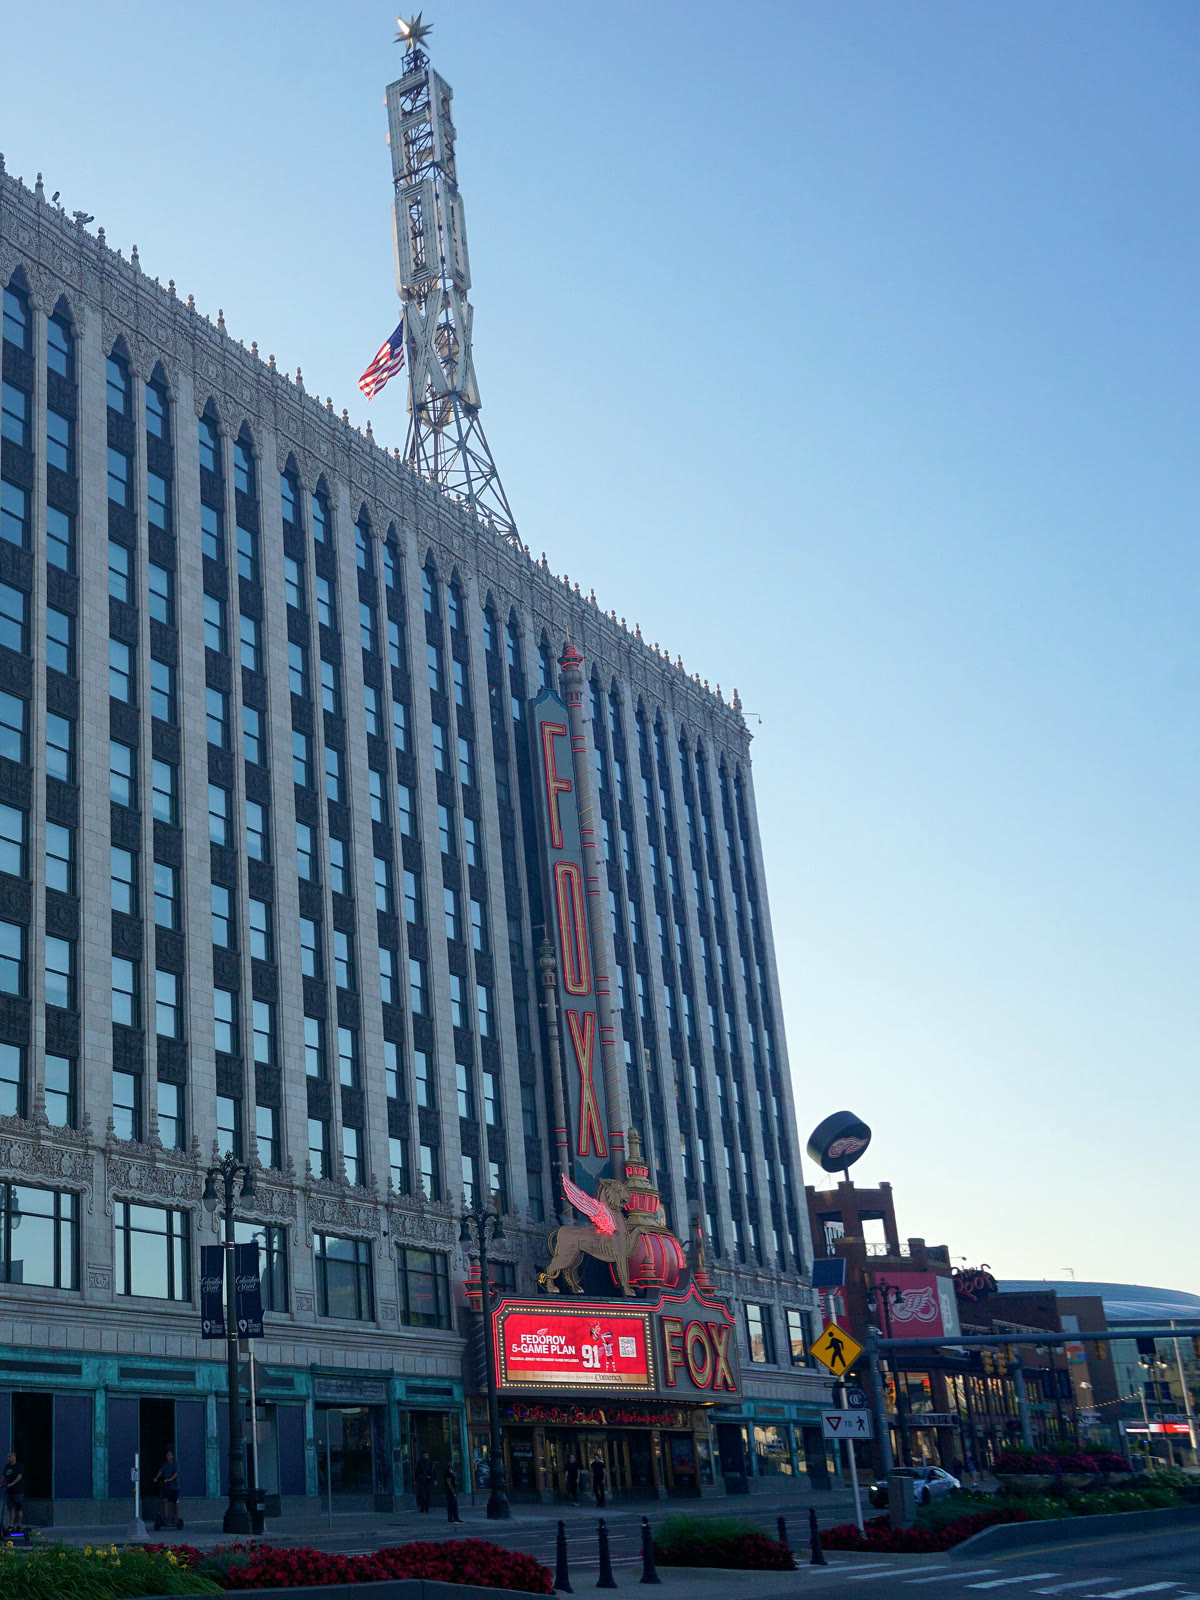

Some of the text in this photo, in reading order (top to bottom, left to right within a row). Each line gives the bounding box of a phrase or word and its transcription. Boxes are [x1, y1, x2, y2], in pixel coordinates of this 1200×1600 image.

[541, 721, 607, 1157] FOX
[520, 1334, 566, 1345] FEDOROV
[512, 1344, 576, 1355] 5-GAME PLAN
[582, 1345, 601, 1368] 91
[660, 1315, 737, 1391] FOX
[844, 1420, 852, 1428] TO
